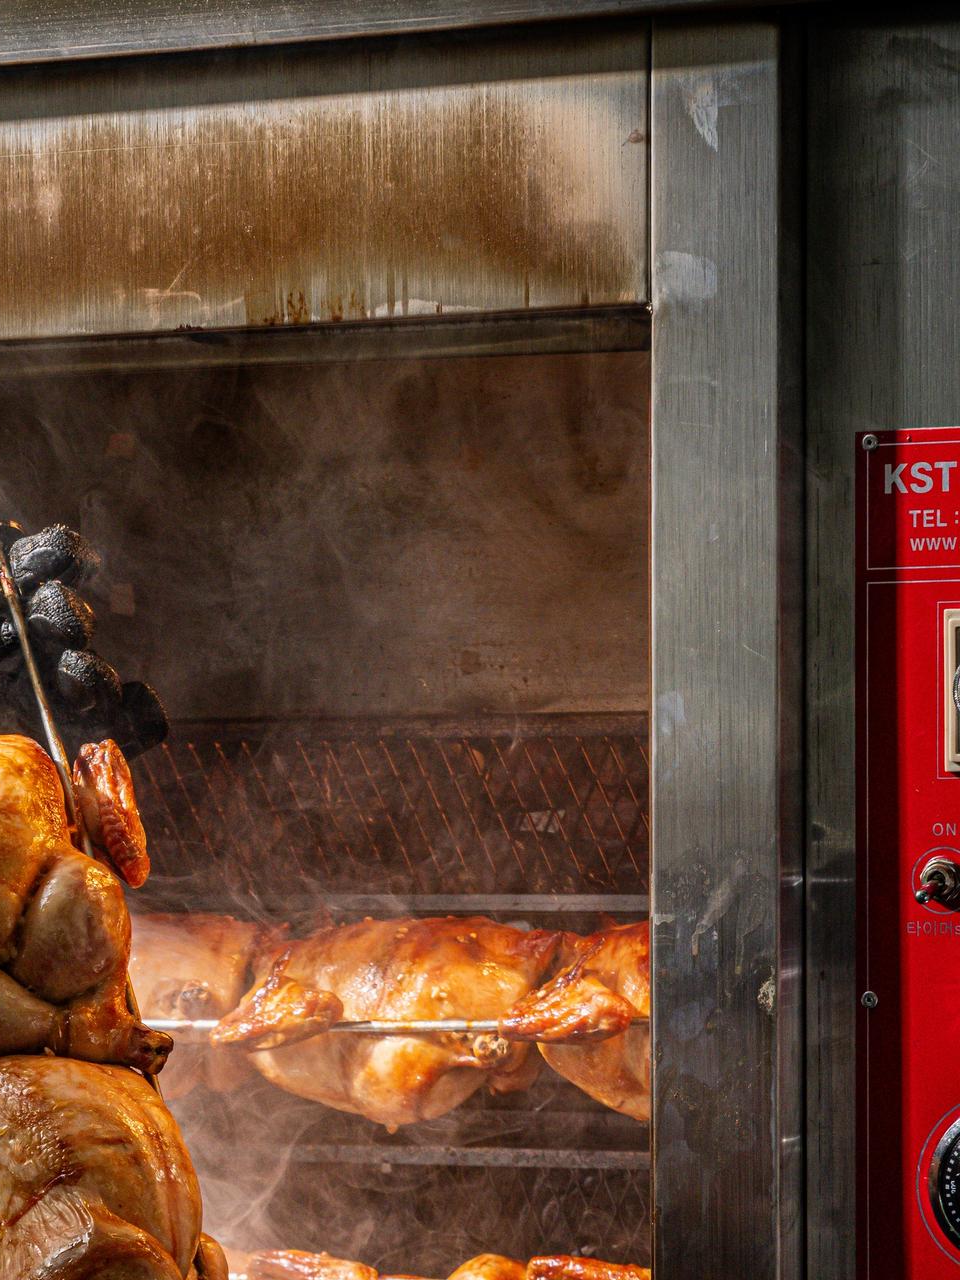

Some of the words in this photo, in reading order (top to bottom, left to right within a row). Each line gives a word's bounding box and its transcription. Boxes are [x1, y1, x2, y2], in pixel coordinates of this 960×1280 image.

[884, 461, 957, 495] KST
[908, 509, 948, 528] TEL
[932, 822, 957, 837] ON
